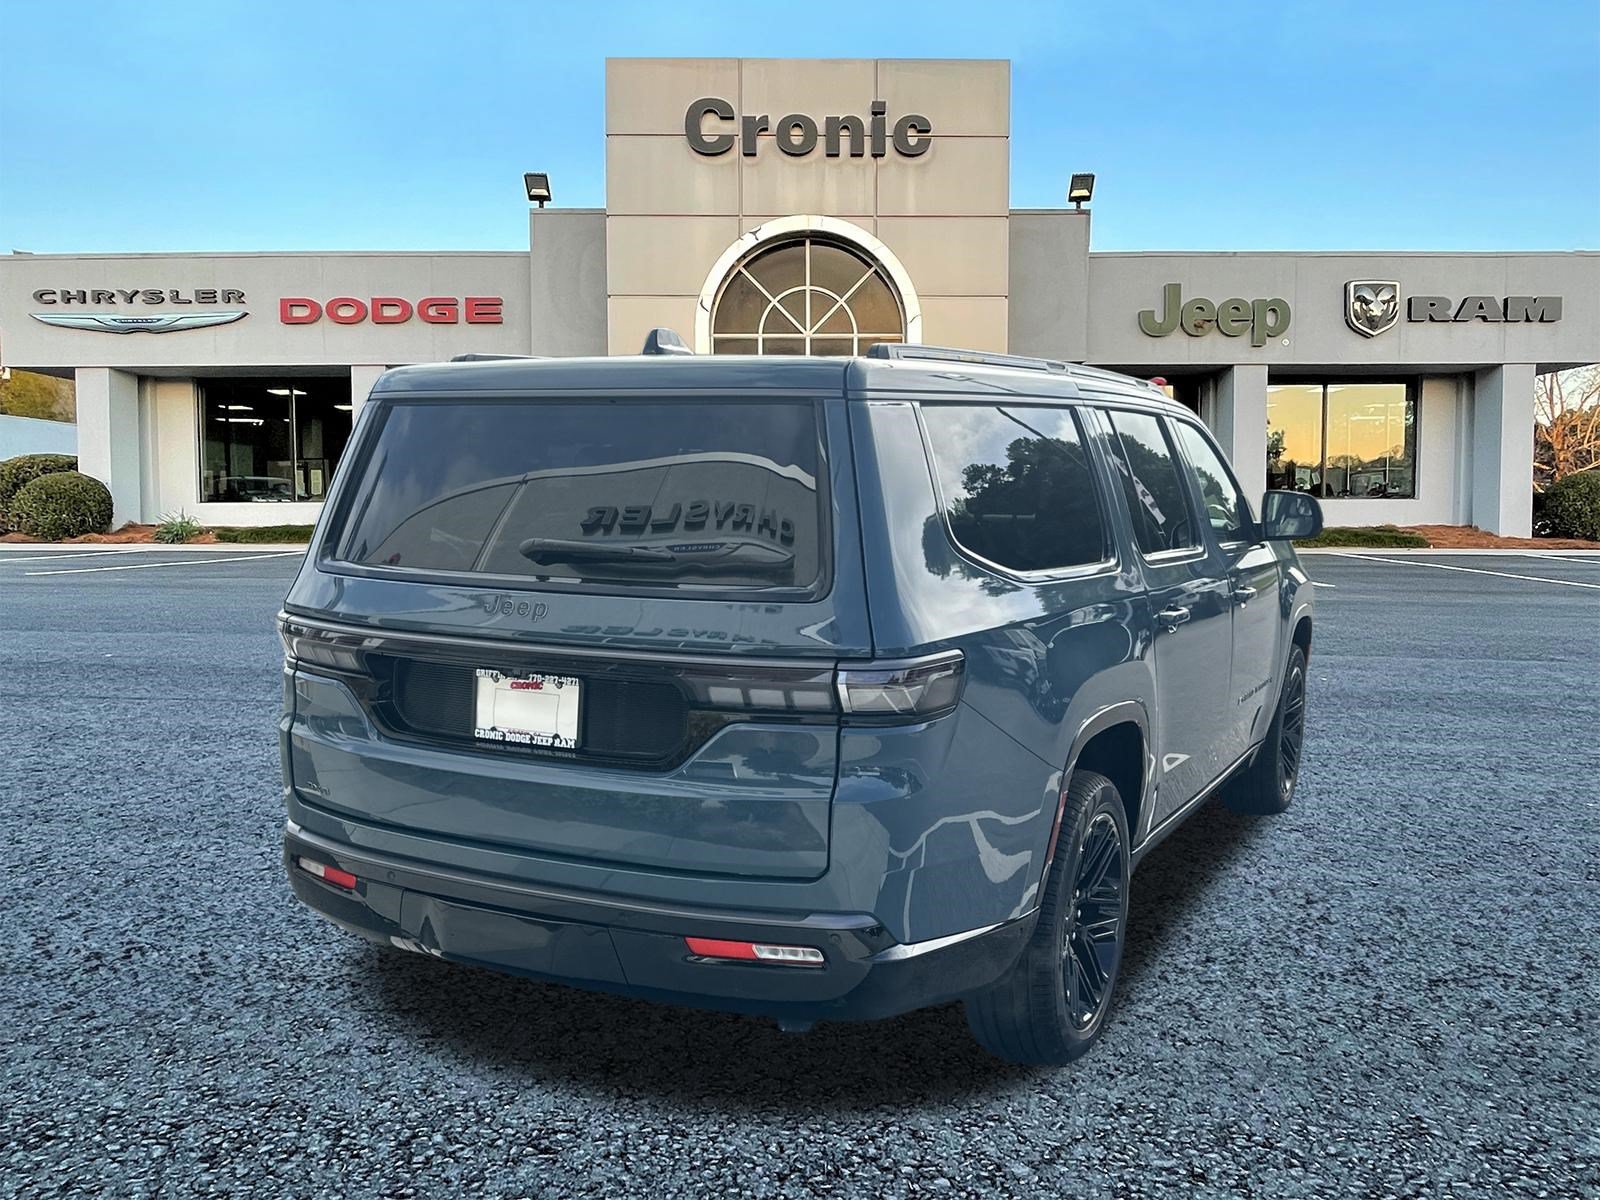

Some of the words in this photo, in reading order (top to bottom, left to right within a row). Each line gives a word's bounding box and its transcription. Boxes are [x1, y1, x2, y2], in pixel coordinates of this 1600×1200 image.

[684, 97, 932, 157] Cronic
[32, 289, 247, 305] CHRYSLER
[1407, 296, 1563, 322] RAM
[280, 297, 503, 325] DODGE
[1138, 283, 1291, 347] Jeep
[483, 595, 549, 622] Jeep
[510, 681, 544, 691] CRONIC
[474, 728, 504, 741] CRONIC
[505, 732, 531, 744] DODGE
[532, 736, 553, 747] JEEP
[554, 737, 576, 749] RAM
